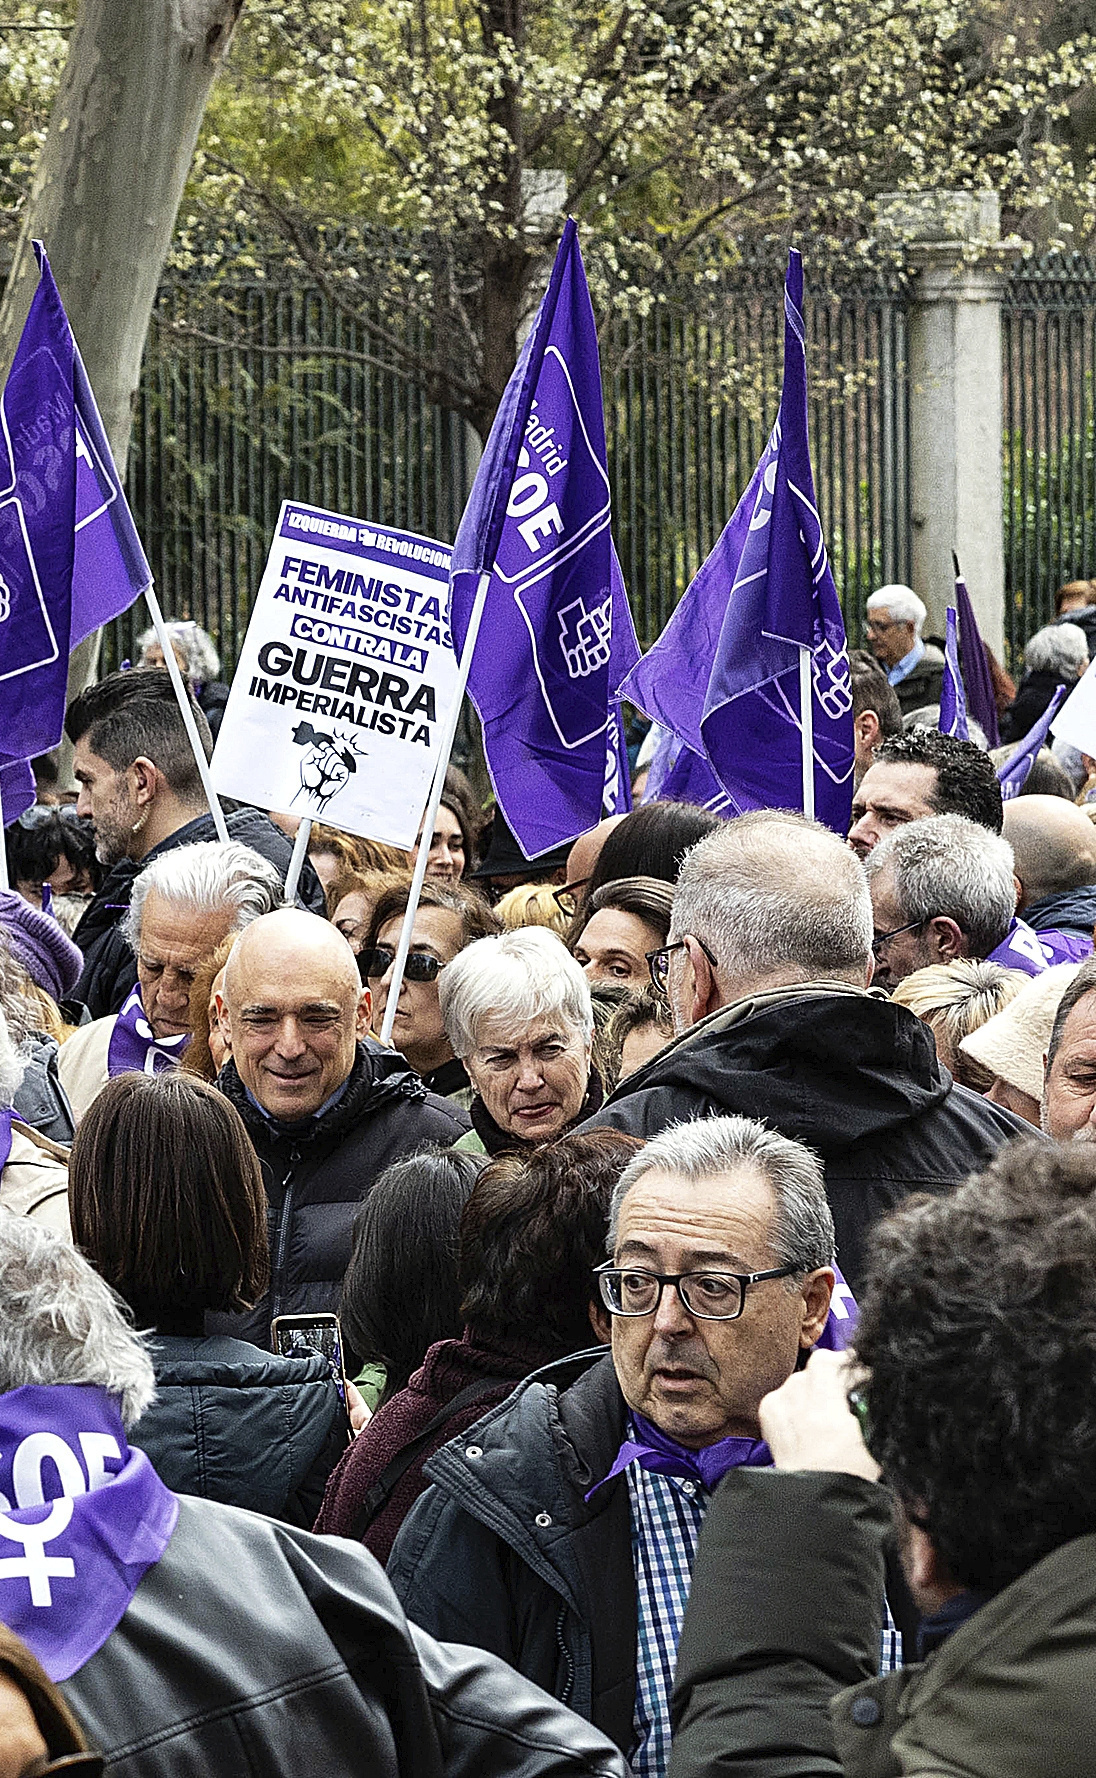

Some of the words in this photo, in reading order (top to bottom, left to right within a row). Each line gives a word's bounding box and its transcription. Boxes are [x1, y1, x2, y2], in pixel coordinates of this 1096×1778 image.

[524, 400, 568, 477] adrid
[287, 511, 358, 543] IZQUIERDA
[273, 583, 455, 650] ANTIFASCISTAS
[248, 675, 432, 748] IMPERIALISTA
[257, 641, 438, 723] GUERRA
